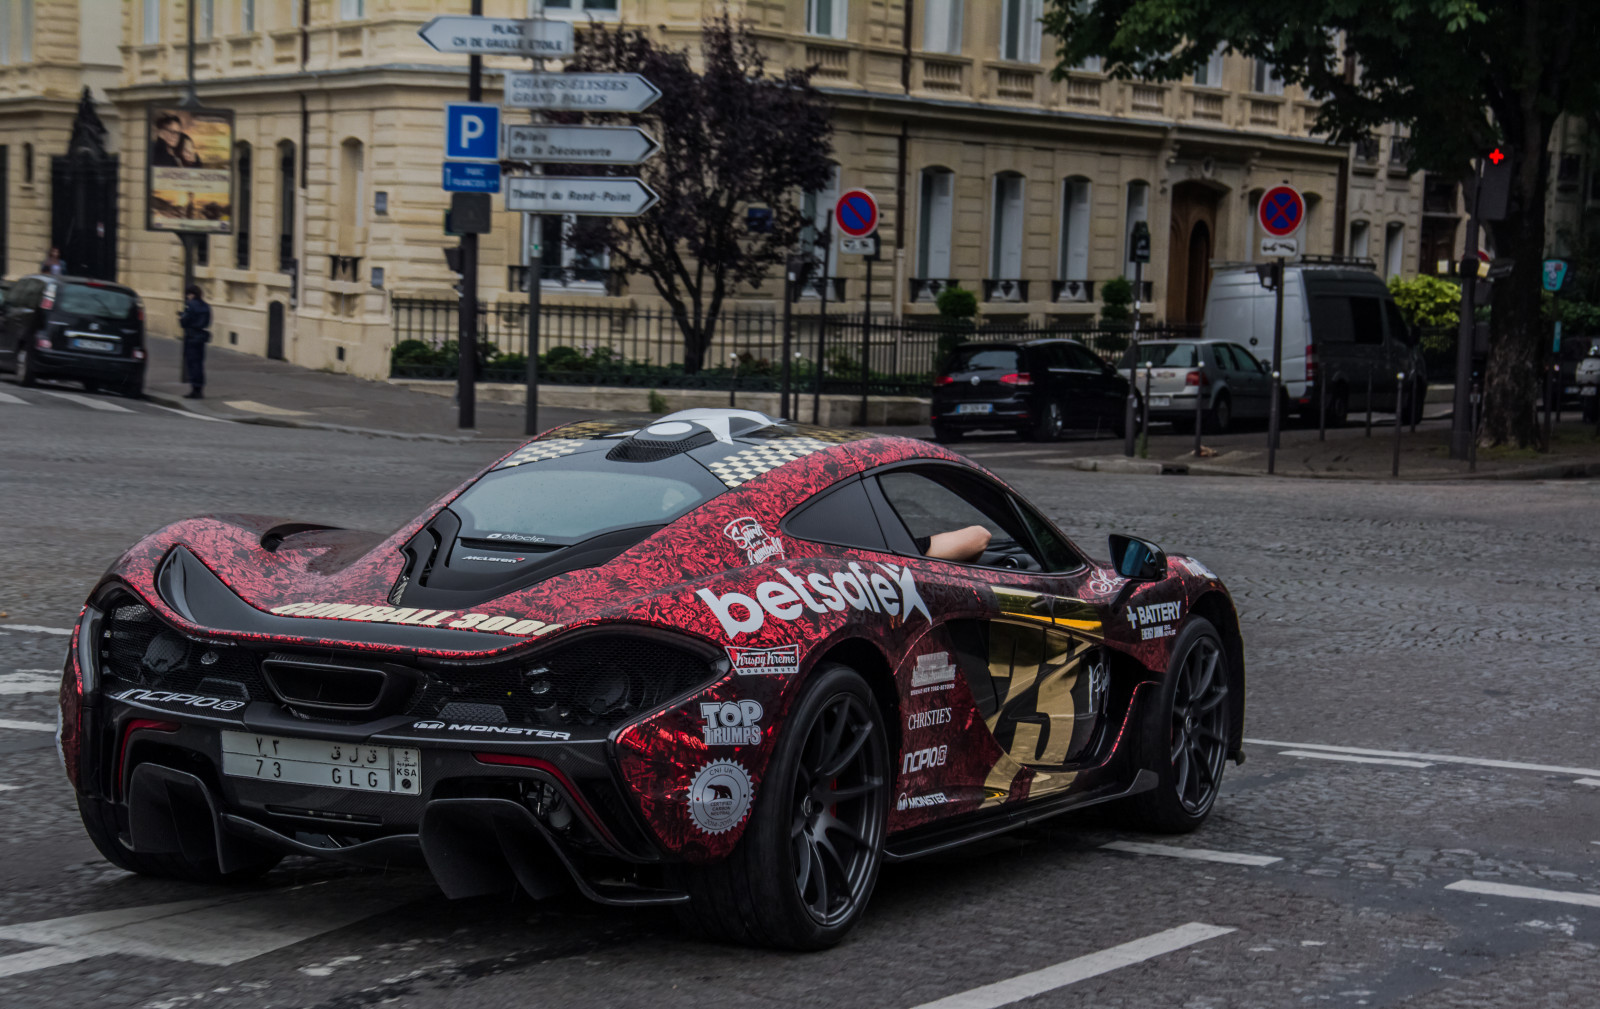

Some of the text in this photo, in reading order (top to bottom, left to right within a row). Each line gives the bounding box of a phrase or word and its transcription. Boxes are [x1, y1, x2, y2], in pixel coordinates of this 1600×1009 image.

[492, 24, 525, 35] PLACE
[470, 37, 483, 48] DE
[486, 38, 524, 49] GAULLE
[512, 92, 608, 105] GRAND PALAIS
[461, 114, 485, 149] P
[513, 131, 547, 142] Palais
[513, 144, 527, 155] de
[532, 144, 544, 154] la
[550, 190, 564, 200] du
[501, 533, 546, 543] olloclip
[462, 555, 517, 564] McLaren
[269, 601, 455, 627] GUMBALL
[1136, 600, 1182, 626] BATTERY
[735, 650, 797, 668] Krispy Kreme
[739, 666, 797, 675] DOUGHNUTS
[700, 699, 763, 729] TOP
[908, 707, 952, 731] CHRISTIE'S
[448, 724, 572, 740] MONSTER
[702, 725, 761, 745] TRUMPS
[396, 768, 417, 777] KSA
[723, 767, 734, 775] UK
[908, 792, 949, 809] MONSTER
